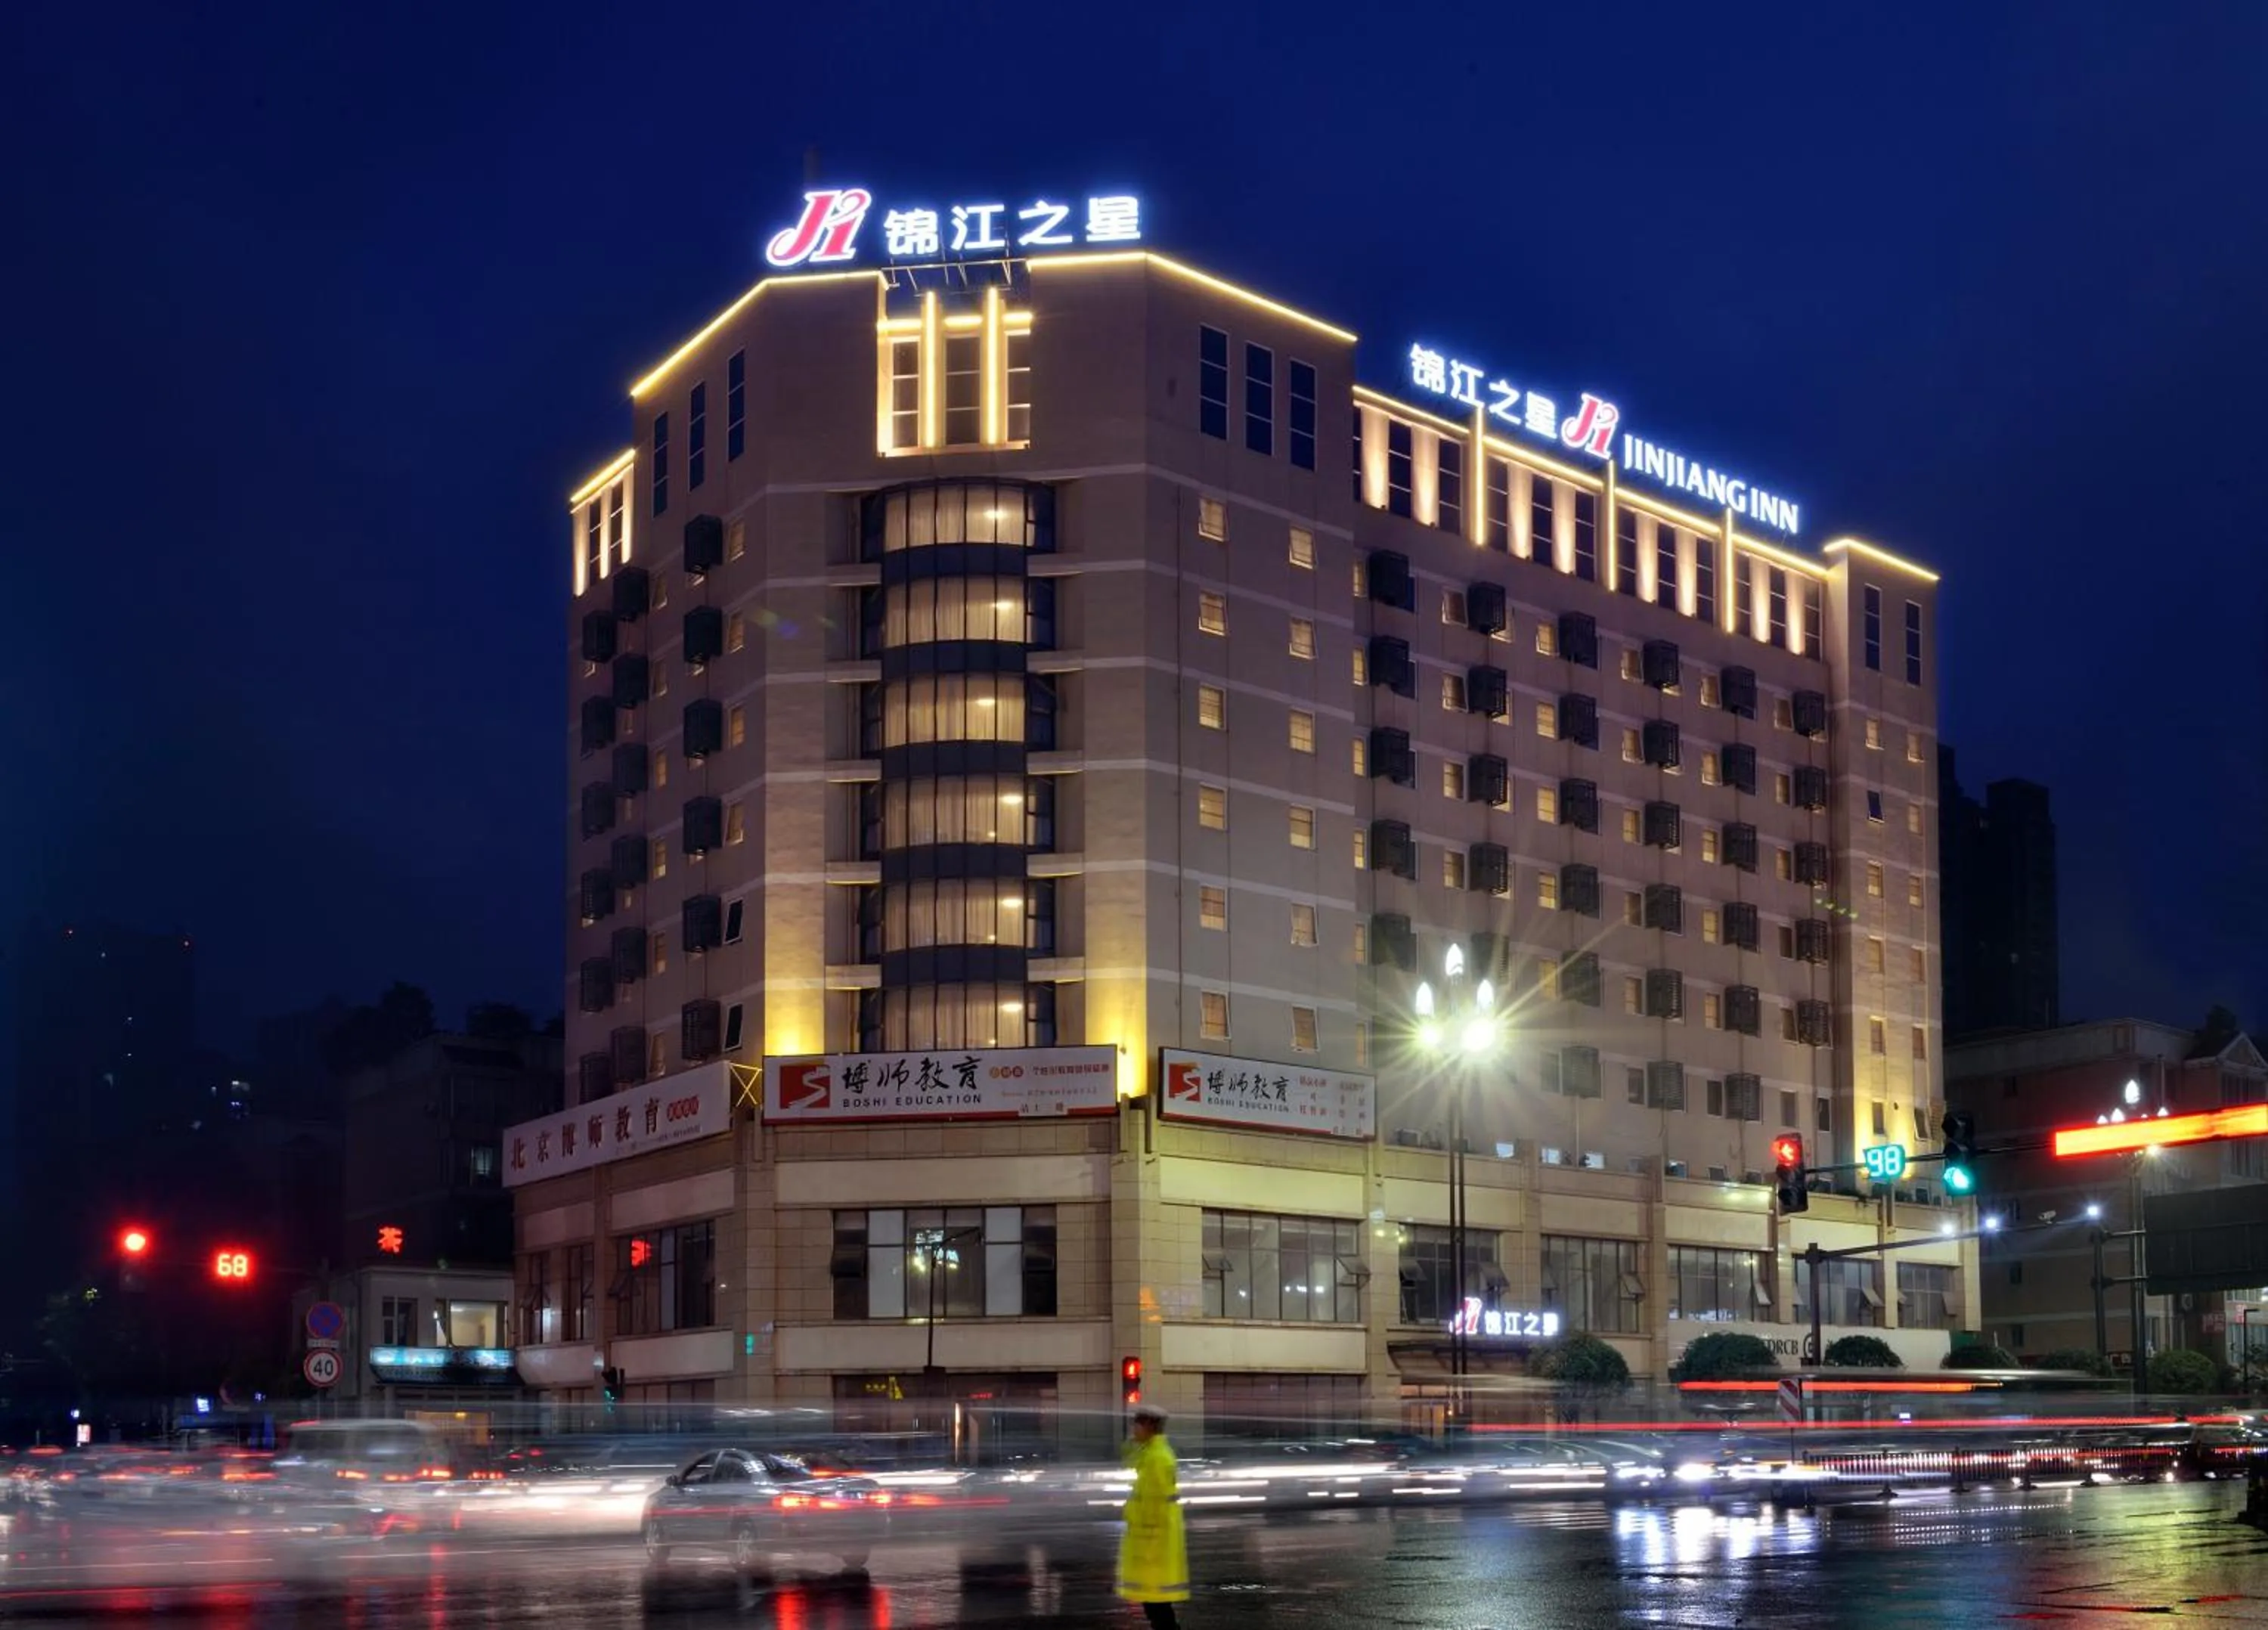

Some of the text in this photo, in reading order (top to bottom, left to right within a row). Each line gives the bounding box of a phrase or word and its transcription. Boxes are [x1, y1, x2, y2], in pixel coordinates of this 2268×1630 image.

[882, 194, 1142, 256] 锦江之星
[1410, 342, 1558, 439] 锦江之星
[1622, 433, 1799, 535] JINJIANG INN
[841, 1055, 983, 1094] 博师教育
[1207, 1070, 1290, 1103] 博师教育
[843, 1094, 981, 1108] BOSHI EDUCATION
[1866, 1145, 1901, 1177] 98
[217, 1253, 248, 1277] 68
[313, 1359, 334, 1377] 40
